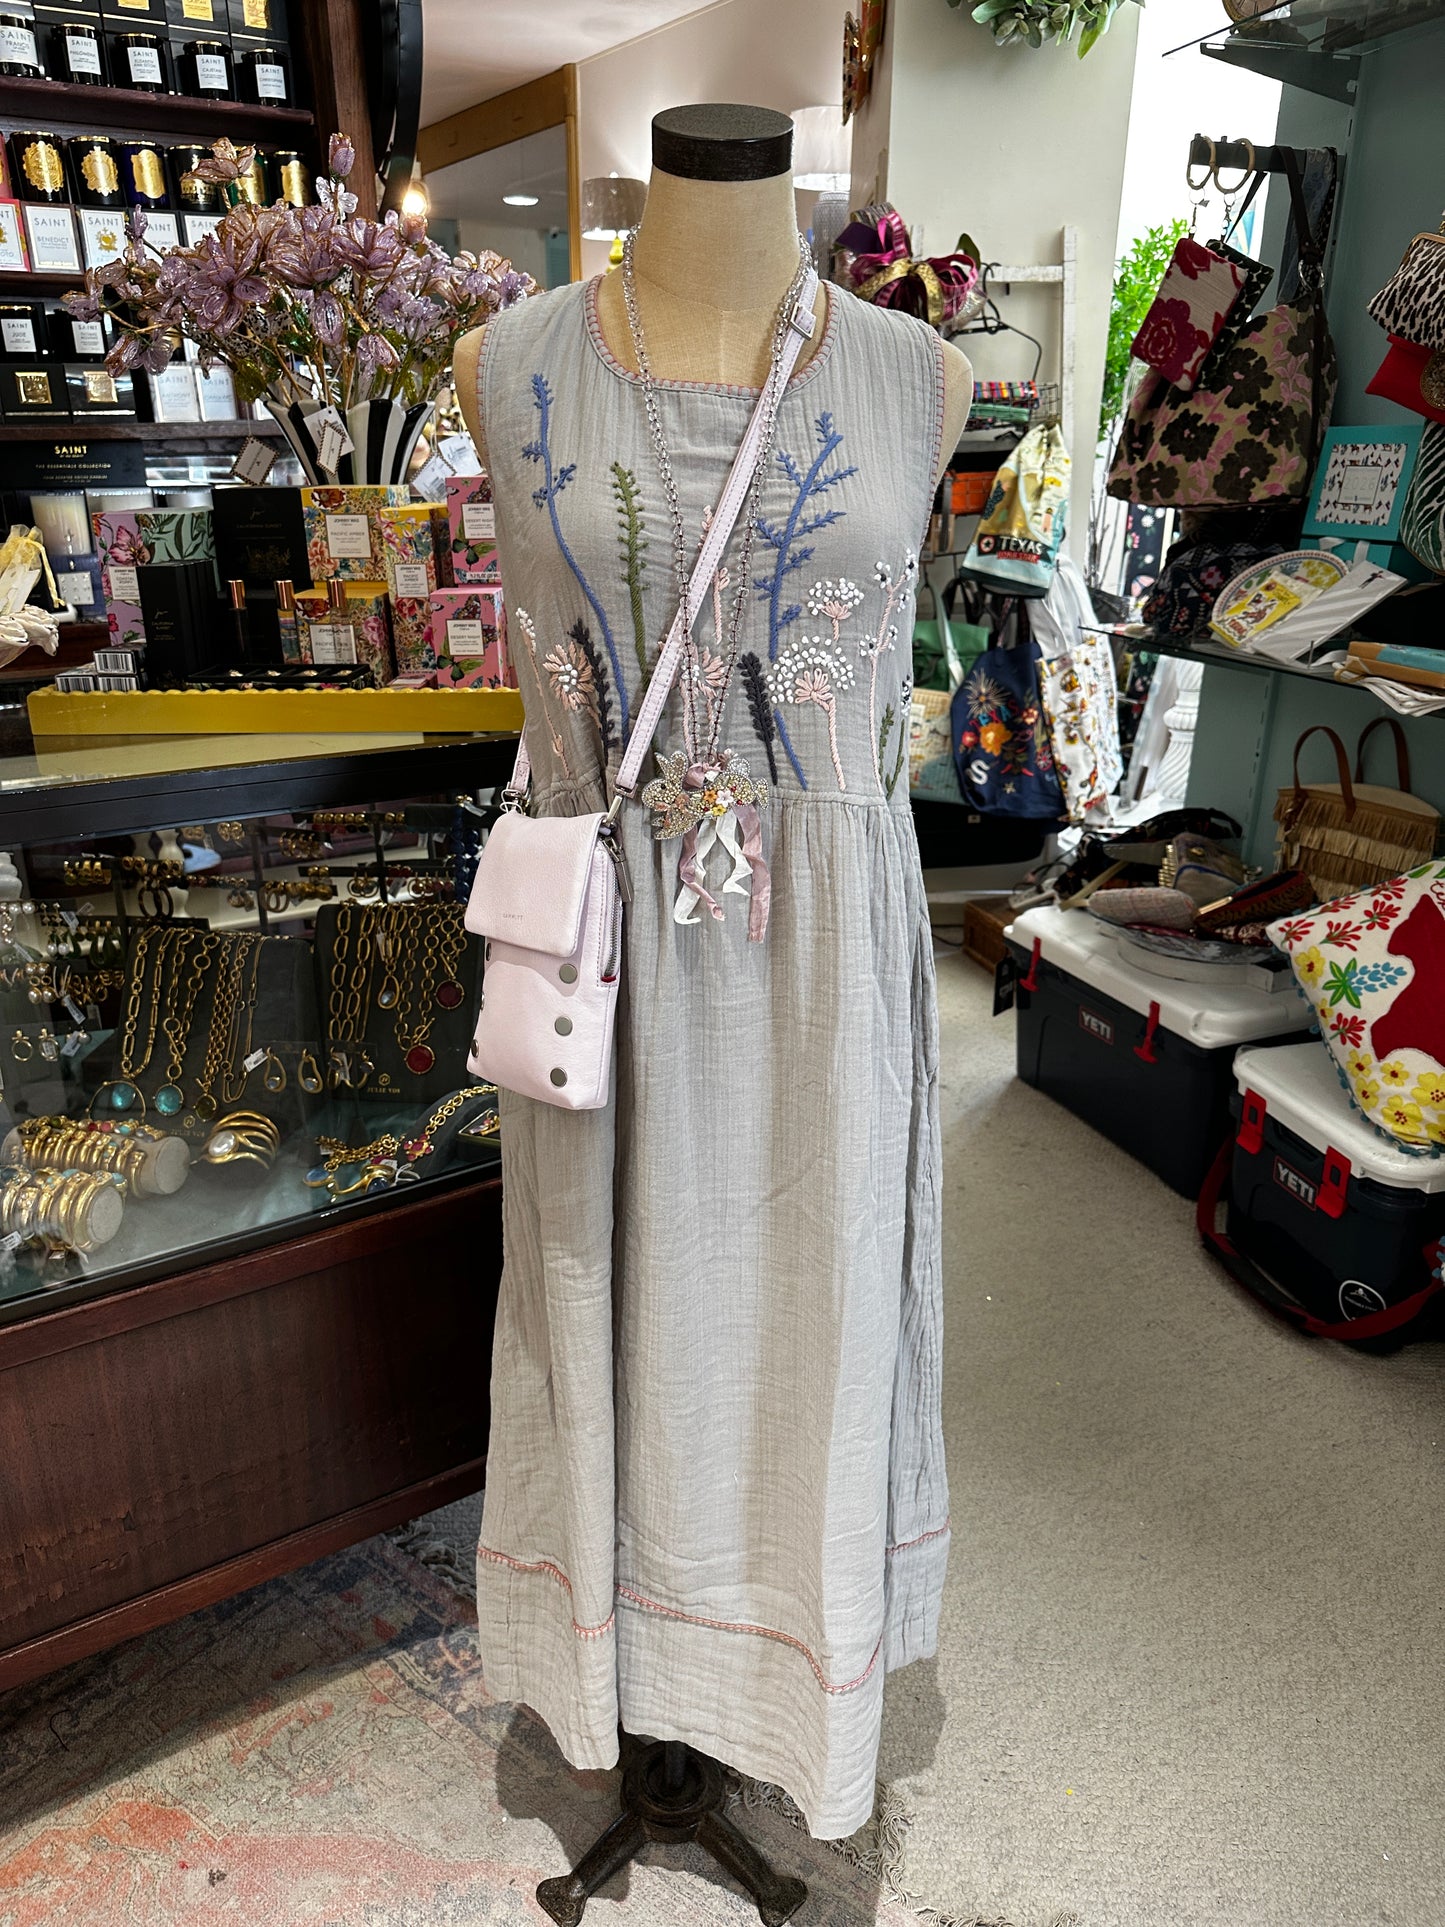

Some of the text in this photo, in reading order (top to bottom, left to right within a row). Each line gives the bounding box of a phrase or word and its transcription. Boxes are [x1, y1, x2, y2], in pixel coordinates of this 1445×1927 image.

[0, 30, 31, 41] SAINT
[71, 39, 92, 47] SAINT
[261, 67, 280, 75] SAINT
[34, 217, 66, 227] SAINT
[88, 216, 119, 226] SAINT
[191, 219, 215, 228] SAIN
[147, 223, 172, 232] AINT
[160, 376, 188, 384] SAINT
[203, 378, 229, 386] SAINT
[54, 445, 87, 454] SAINT
[1000, 536, 1042, 555] TEXAS
[1081, 1011, 1110, 1039] YETI
[1278, 1162, 1314, 1204] YETI
